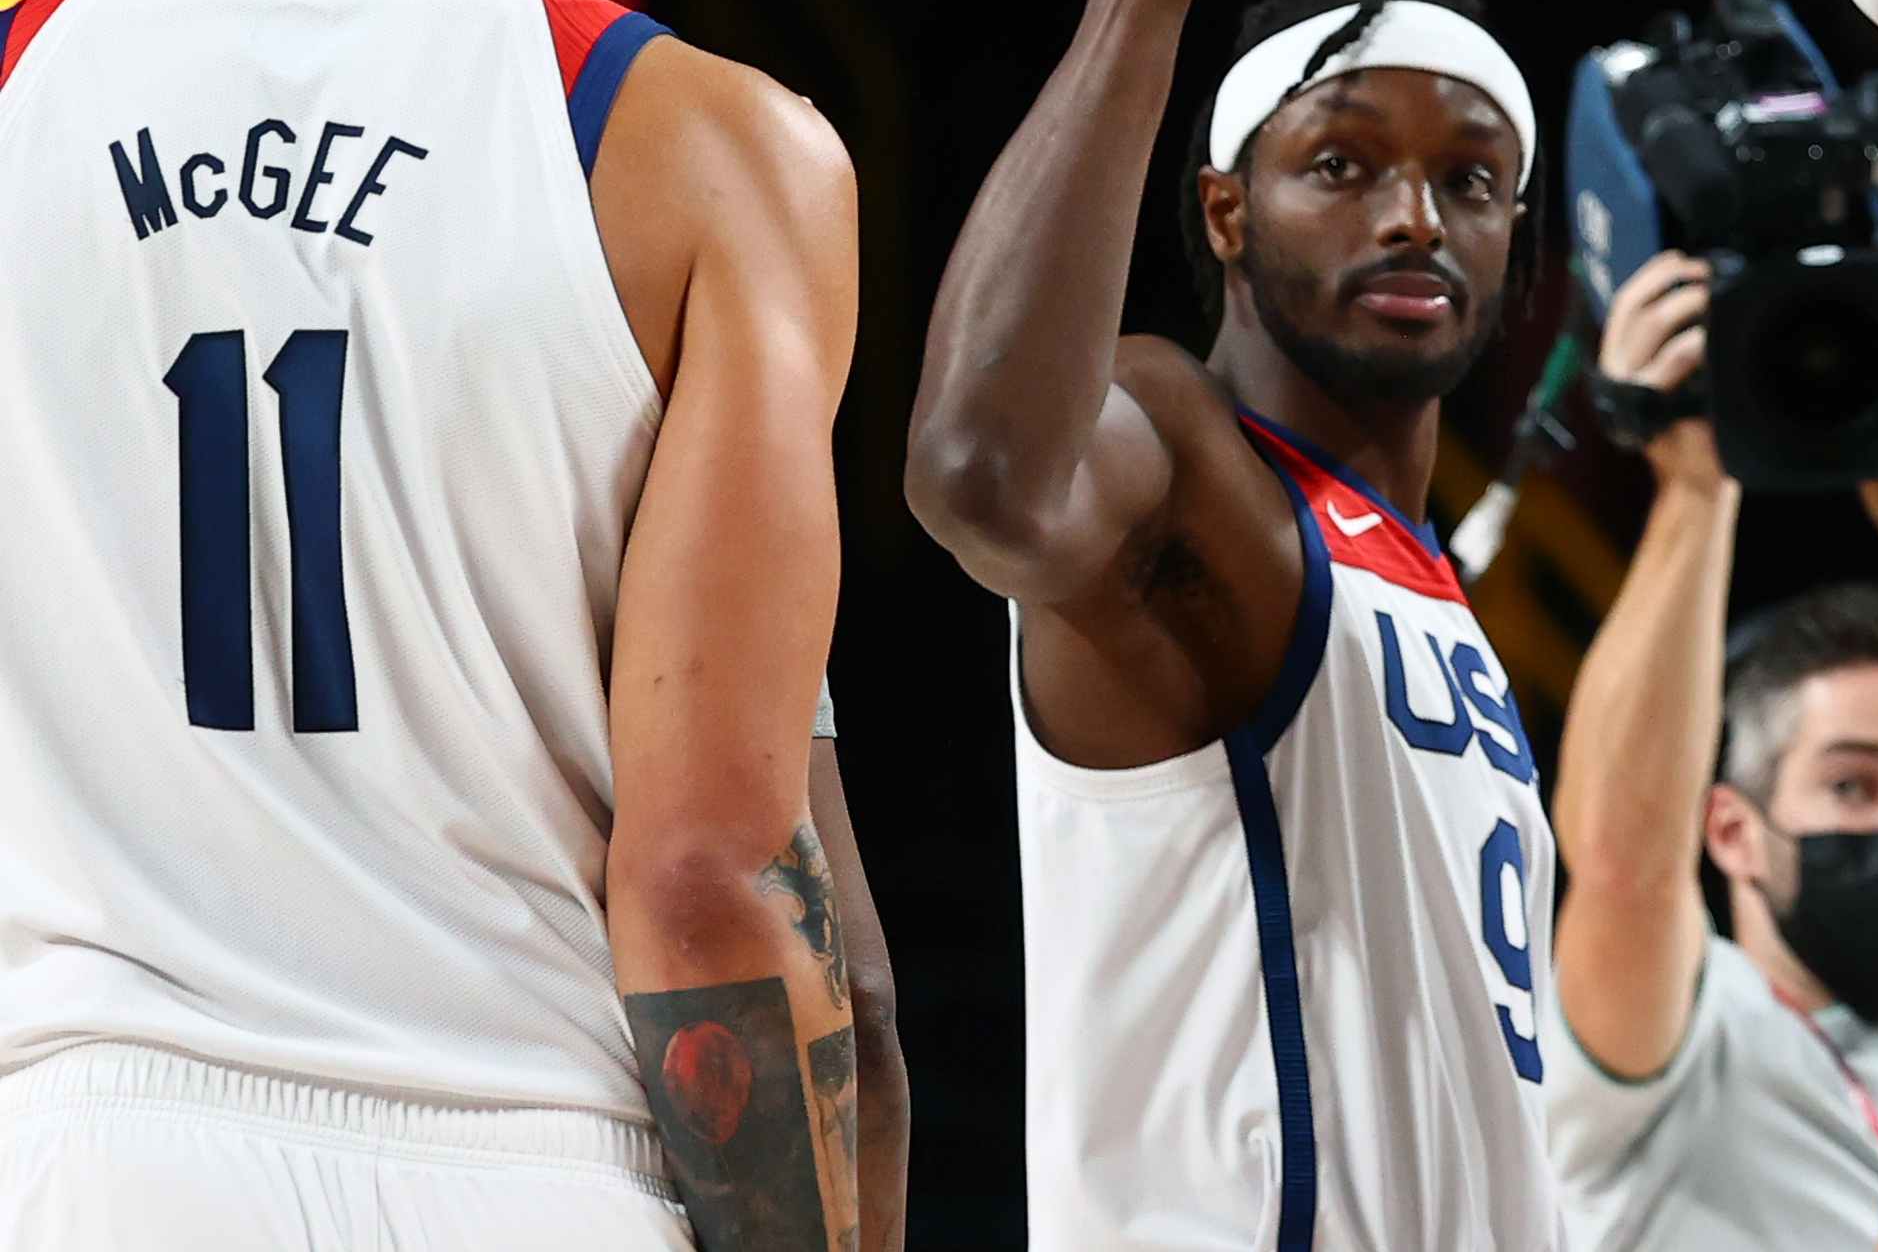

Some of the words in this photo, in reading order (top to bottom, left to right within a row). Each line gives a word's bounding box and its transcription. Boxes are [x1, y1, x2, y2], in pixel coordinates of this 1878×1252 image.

[108, 119, 429, 247] McGEE
[162, 329, 359, 733] 11
[1374, 610, 1540, 786] US
[1480, 817, 1543, 1085] 9
